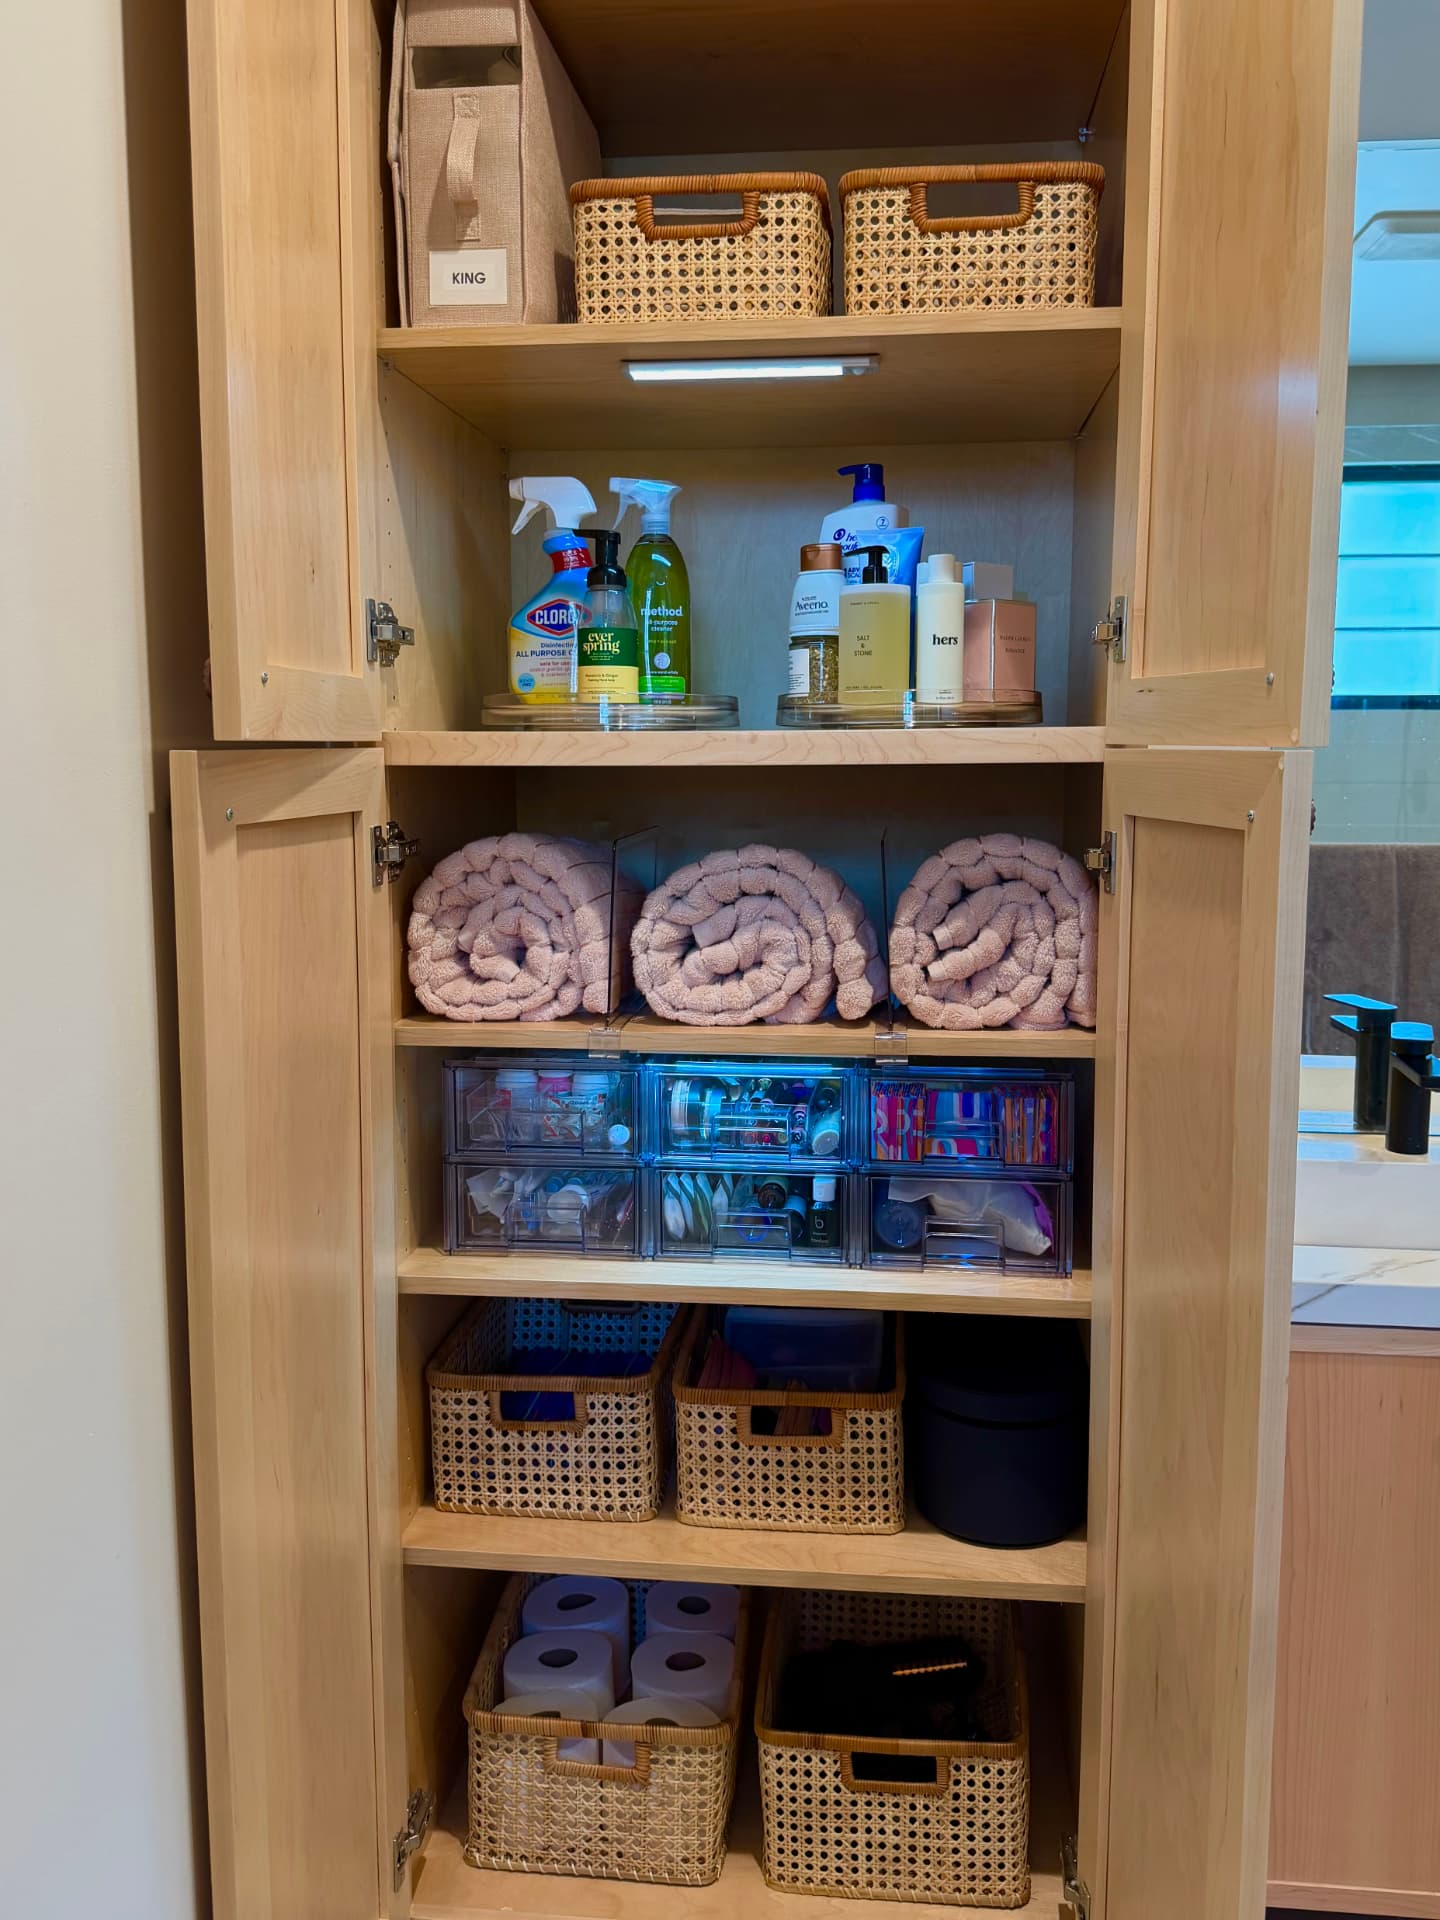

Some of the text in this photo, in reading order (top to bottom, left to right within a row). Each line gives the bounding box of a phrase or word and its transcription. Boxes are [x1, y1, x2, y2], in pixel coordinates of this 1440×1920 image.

[452, 271, 487, 285] KING
[641, 605, 683, 617] method
[588, 632, 614, 642] ever
[932, 634, 959, 646] hers
[583, 639, 620, 655] spring
[516, 650, 529, 658] ALL
[530, 649, 567, 657] PURPOSE
